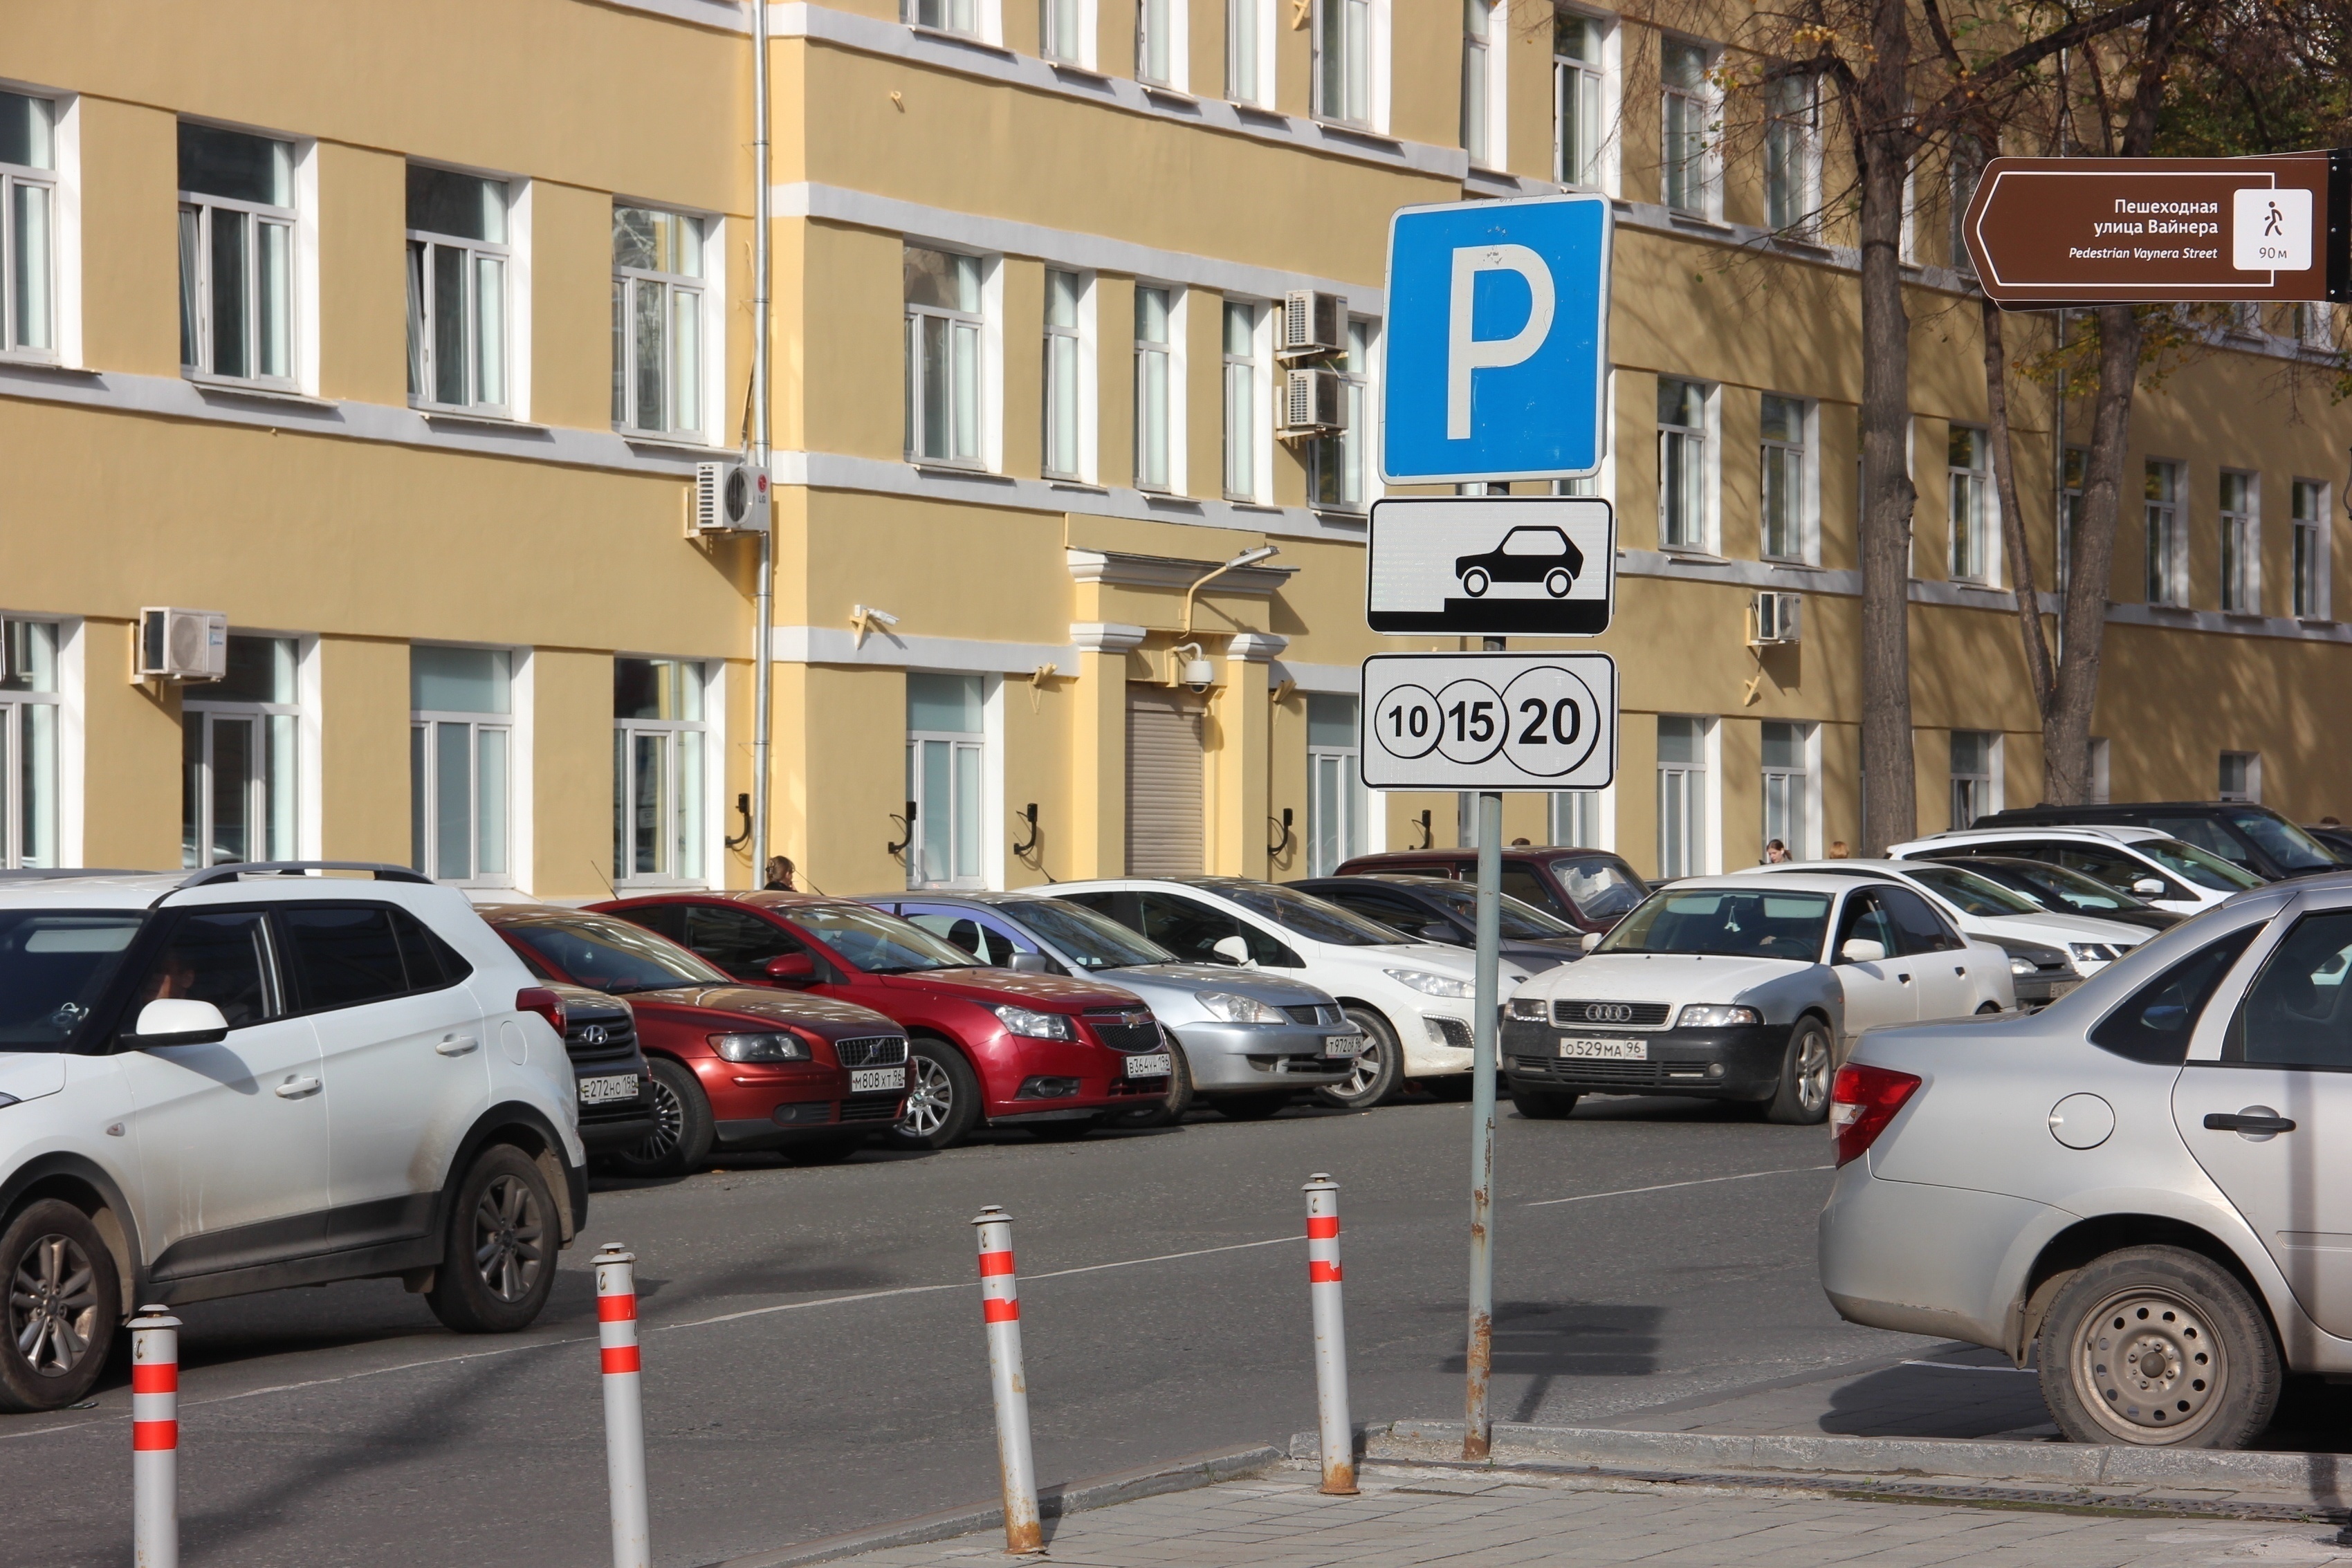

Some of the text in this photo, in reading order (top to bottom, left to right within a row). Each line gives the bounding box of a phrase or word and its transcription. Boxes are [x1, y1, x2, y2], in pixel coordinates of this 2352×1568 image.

[2114, 199, 2218, 216] Пешеходная
[2093, 219, 2218, 237] улица Вайнера
[2068, 247, 2218, 261] Pedestrian Vaynera Street
[1447, 244, 1555, 440] P
[758, 495, 766, 504] LG
[1388, 697, 1581, 746] 10 15 20
